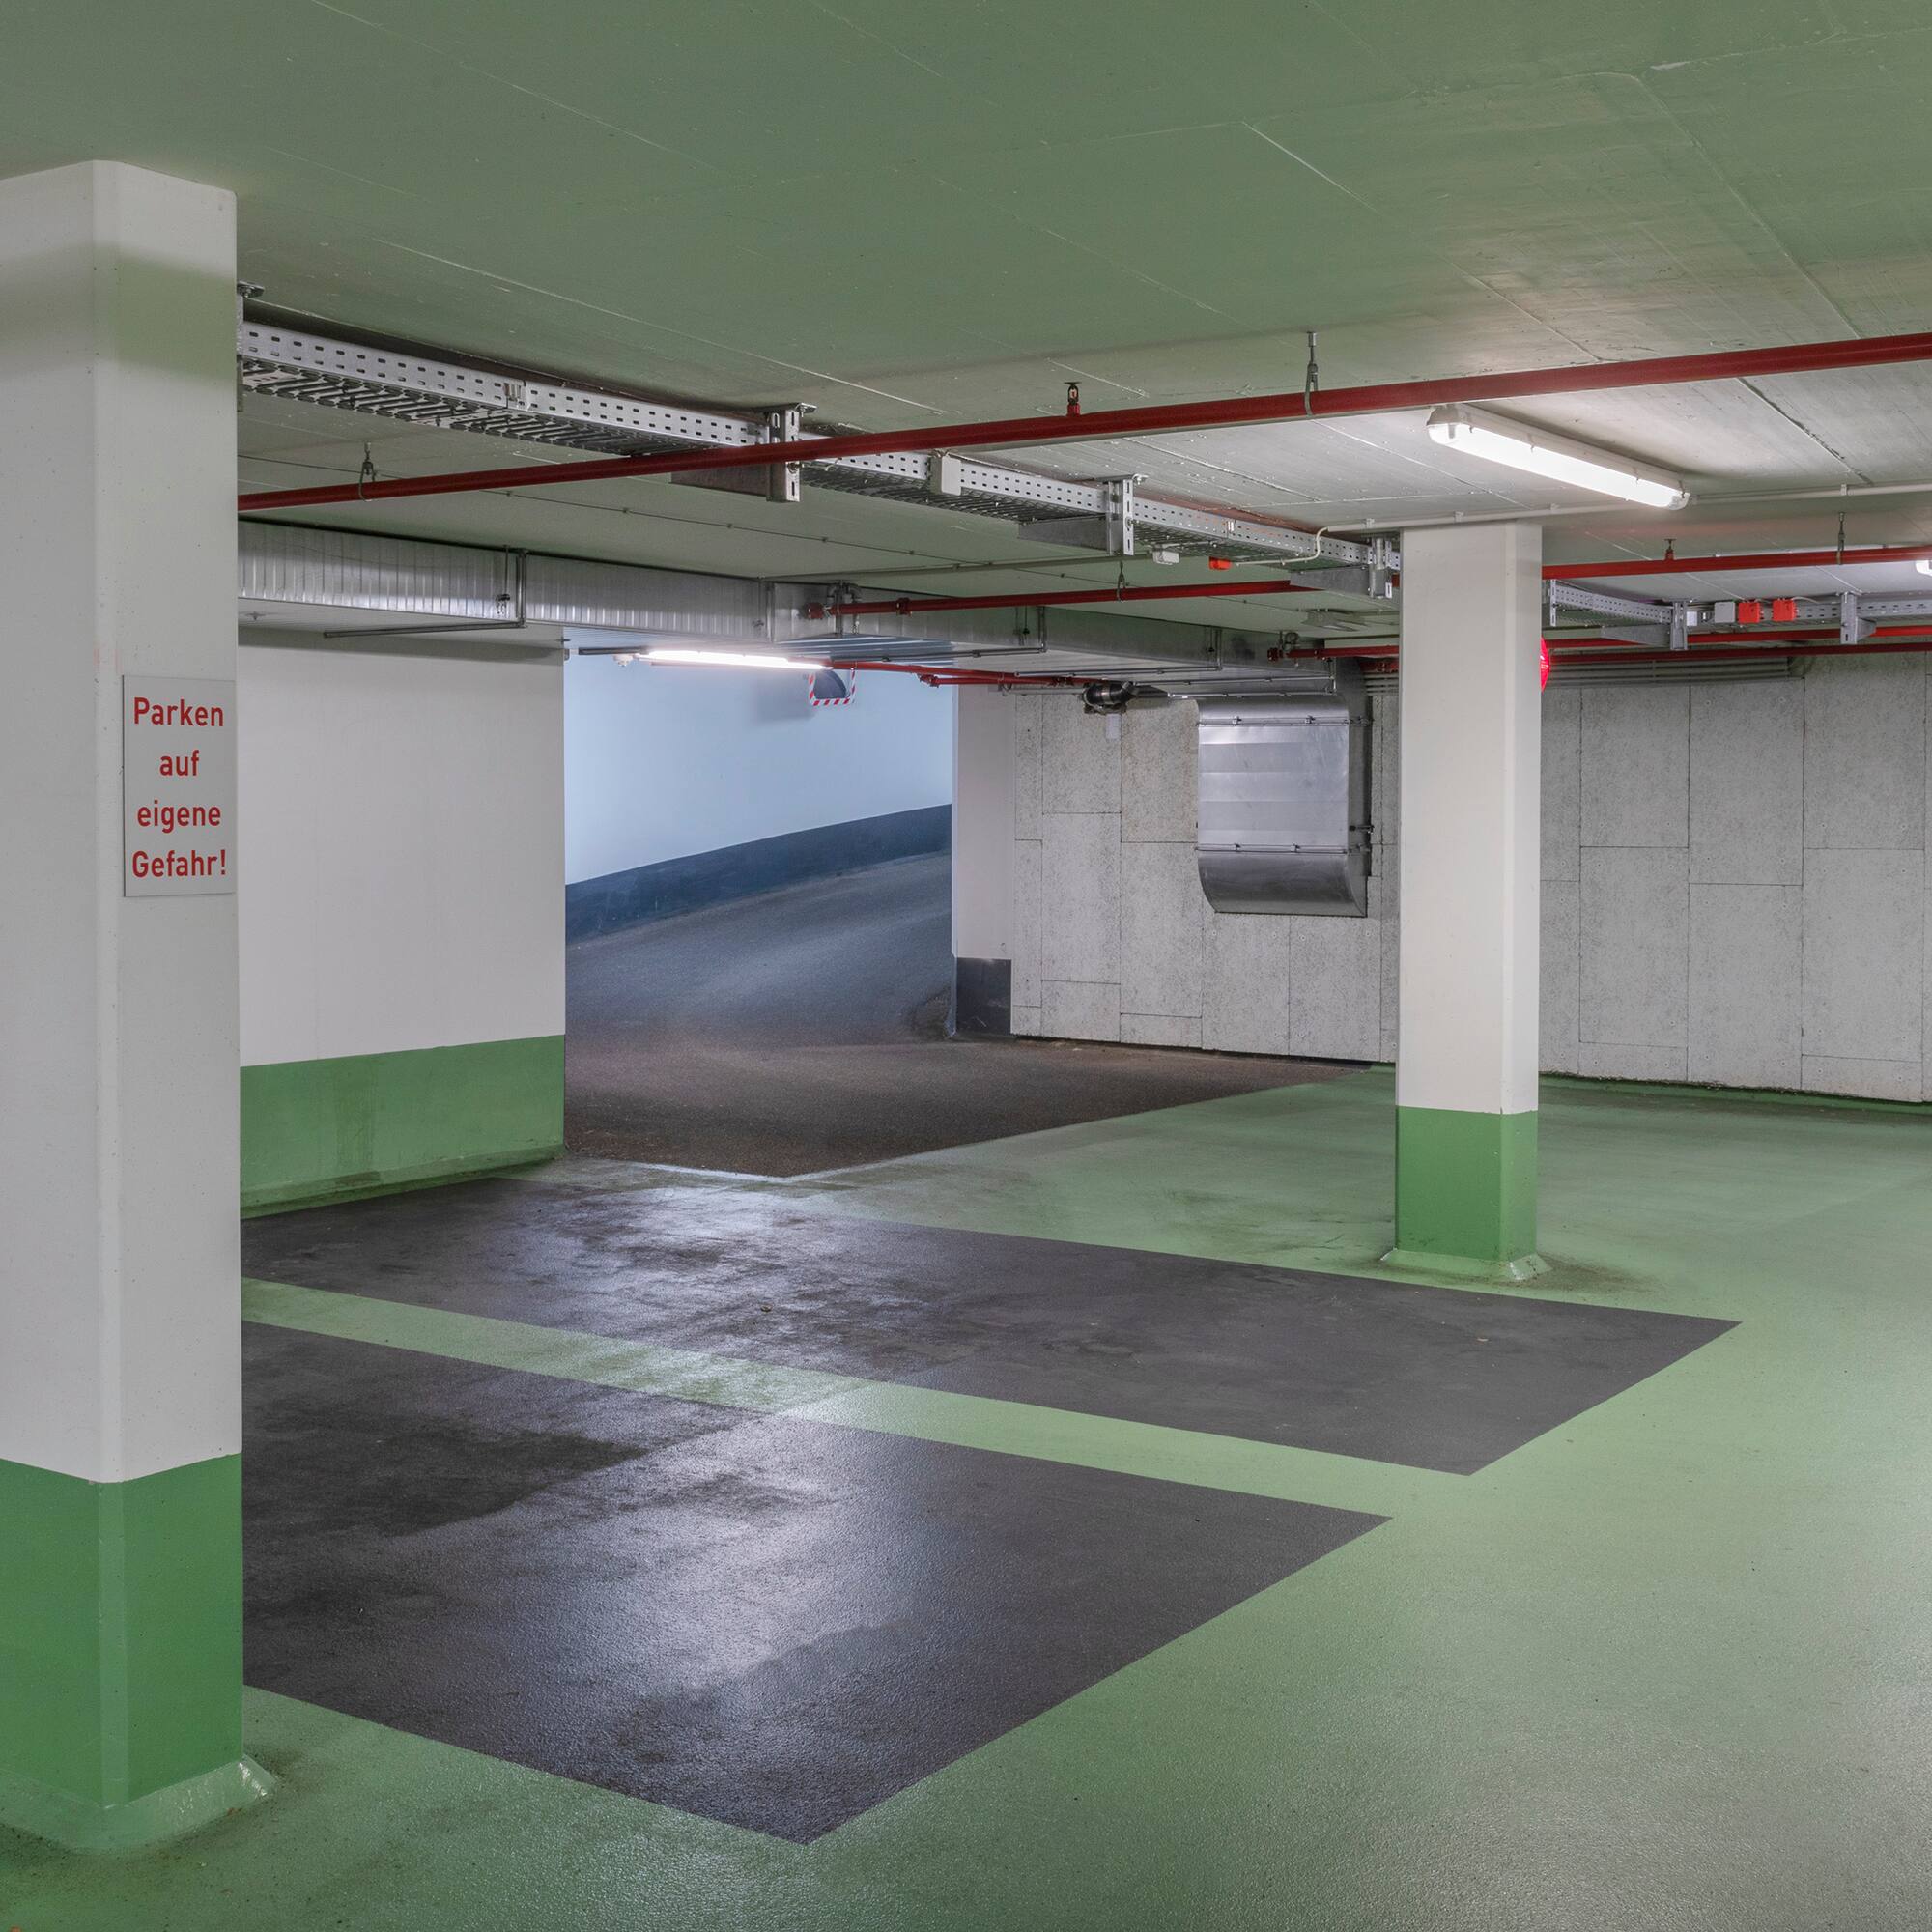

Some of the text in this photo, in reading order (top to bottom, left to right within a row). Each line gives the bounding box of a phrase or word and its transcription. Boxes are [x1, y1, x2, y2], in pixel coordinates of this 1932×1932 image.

[133, 696, 224, 727] Parken
[159, 750, 200, 777] auf
[136, 800, 221, 834] eigene
[131, 849, 226, 878] Gefahr!
